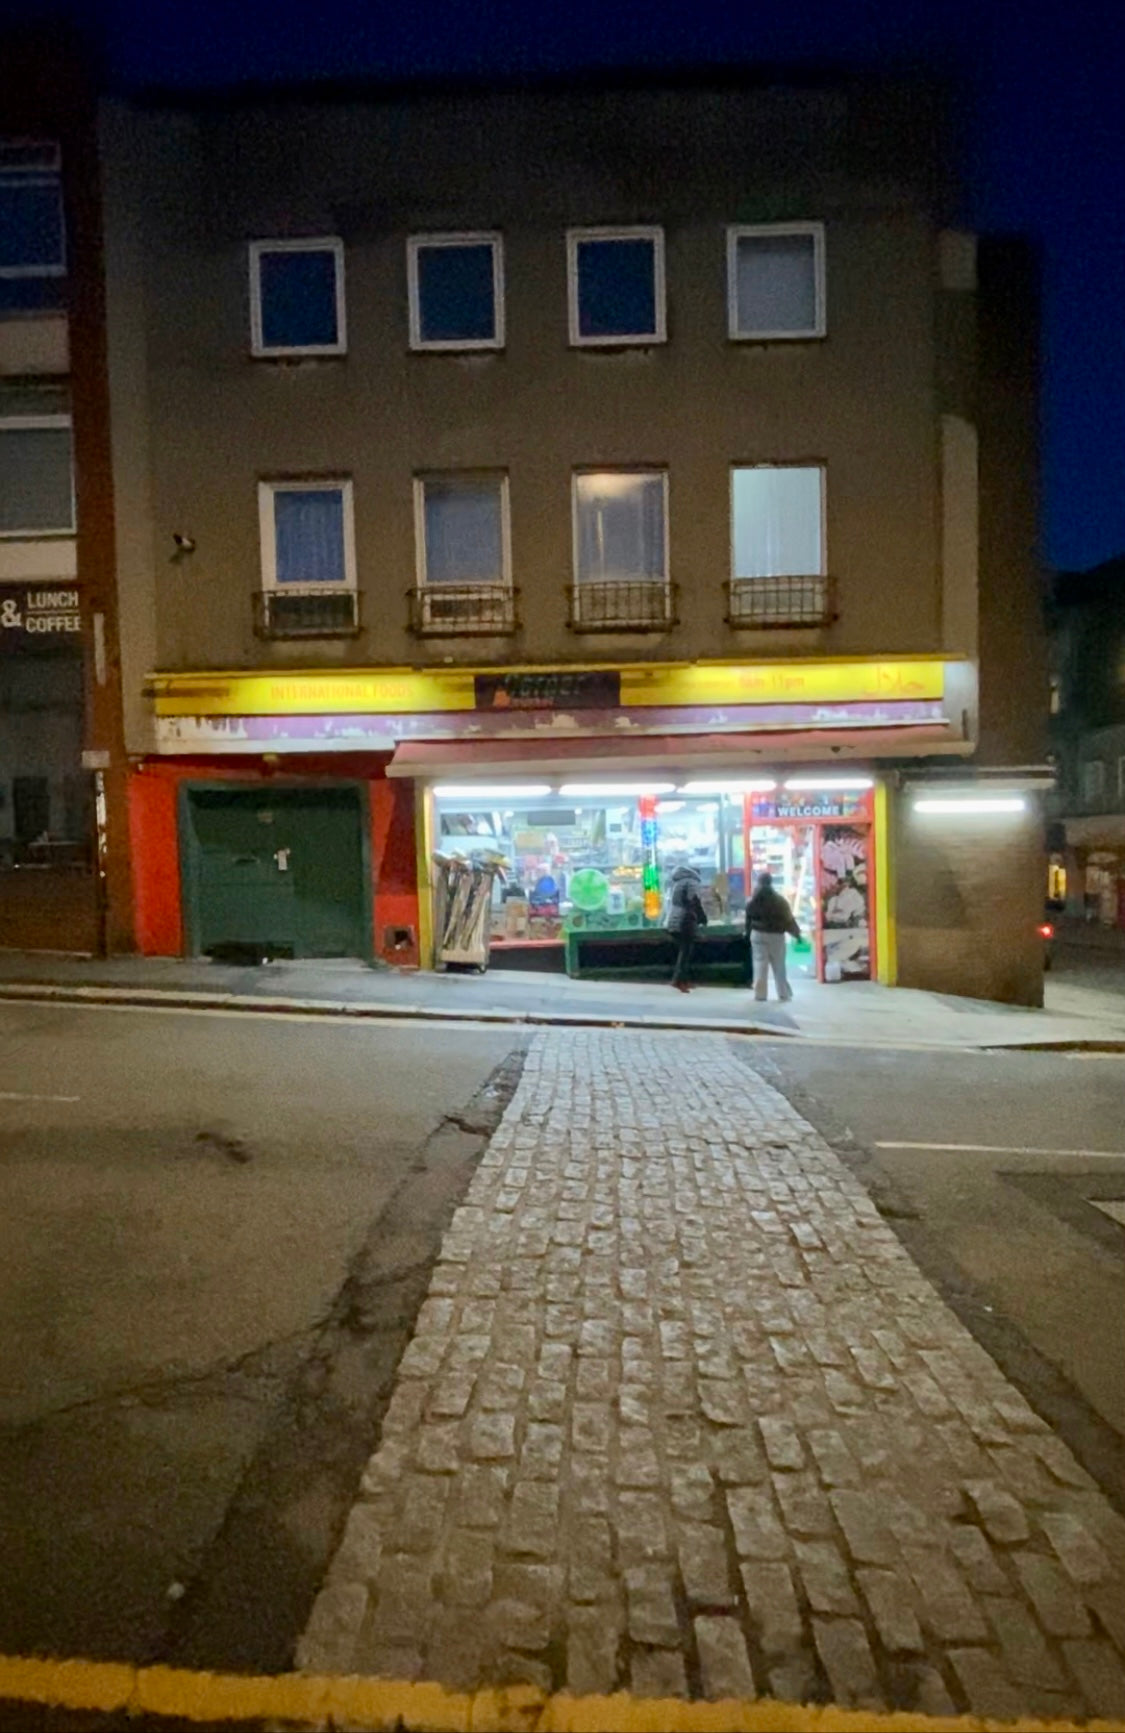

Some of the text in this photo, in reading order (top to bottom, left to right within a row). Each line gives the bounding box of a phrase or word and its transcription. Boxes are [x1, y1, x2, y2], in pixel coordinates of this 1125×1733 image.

[27, 591, 79, 608] LUNCH
[1, 599, 22, 628] &
[26, 616, 81, 633] COFFEE
[778, 804, 840, 817] WELCOME
